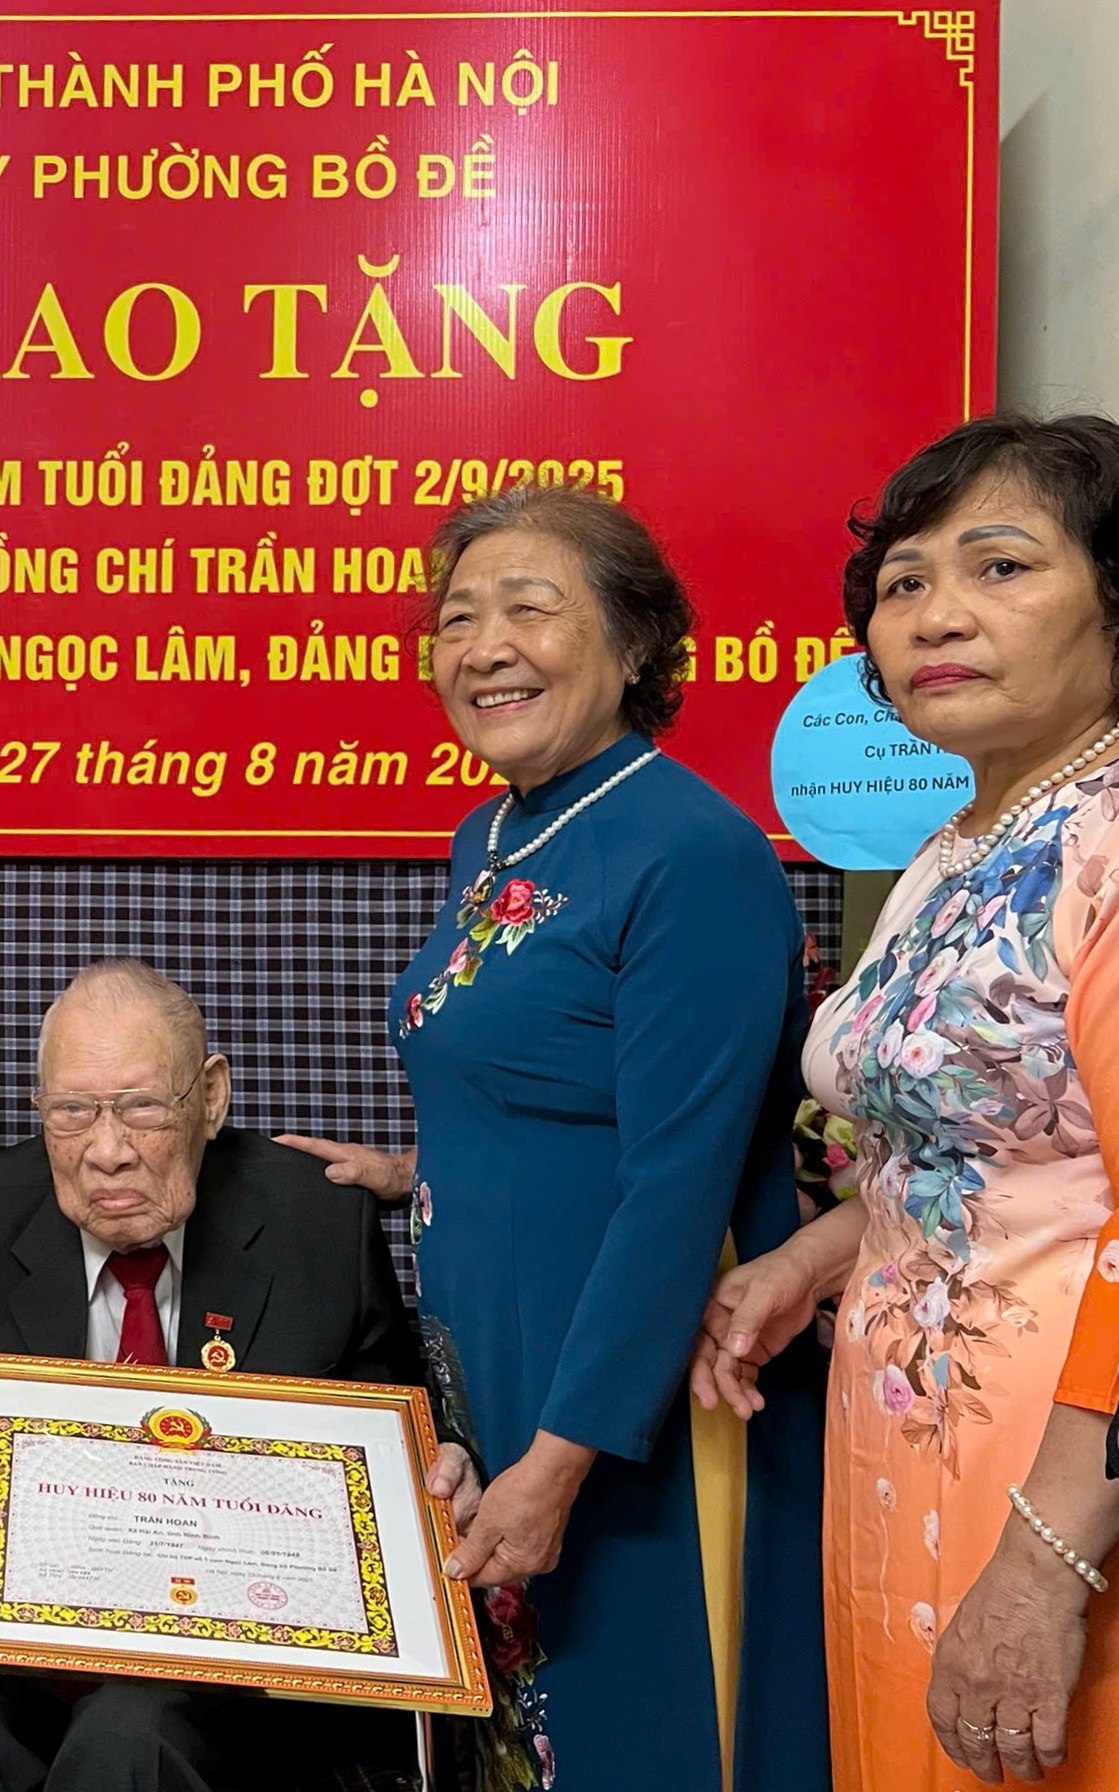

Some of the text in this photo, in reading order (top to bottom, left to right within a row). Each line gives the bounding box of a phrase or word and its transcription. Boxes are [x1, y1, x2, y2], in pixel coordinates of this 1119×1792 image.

[209, 44, 334, 108] PHỐ
[355, 50, 436, 107] HÀ
[458, 49, 559, 116] NỘI
[34, 143, 287, 200] PHƯỜNG
[311, 135, 397, 200] BỒ
[416, 134, 496, 199] ĐỀ
[243, 254, 633, 408] TẶNG
[38, 442, 143, 506] TUỔI
[159, 445, 290, 506] ĐẢNG
[306, 455, 399, 516] ĐỢT
[96, 537, 174, 594] CHÍ
[190, 532, 315, 593] TRẦN
[136, 626, 250, 687] LÂM,
[267, 617, 400, 681] ĐẢNG
[715, 620, 777, 683] BỒ
[803, 713, 831, 728] Các
[834, 711, 869, 726] Con,
[865, 745, 885, 761] Cụ
[889, 738, 931, 757] TRẦN
[75, 739, 227, 797] tháng
[245, 743, 276, 786] 8
[293, 741, 408, 785] năm
[791, 772, 970, 798] nhận HUY HIỆU 80 NĂM
[38, 1482, 323, 1520] HUY HIỆU 80 NĂM TUỔI ĐẢNG
